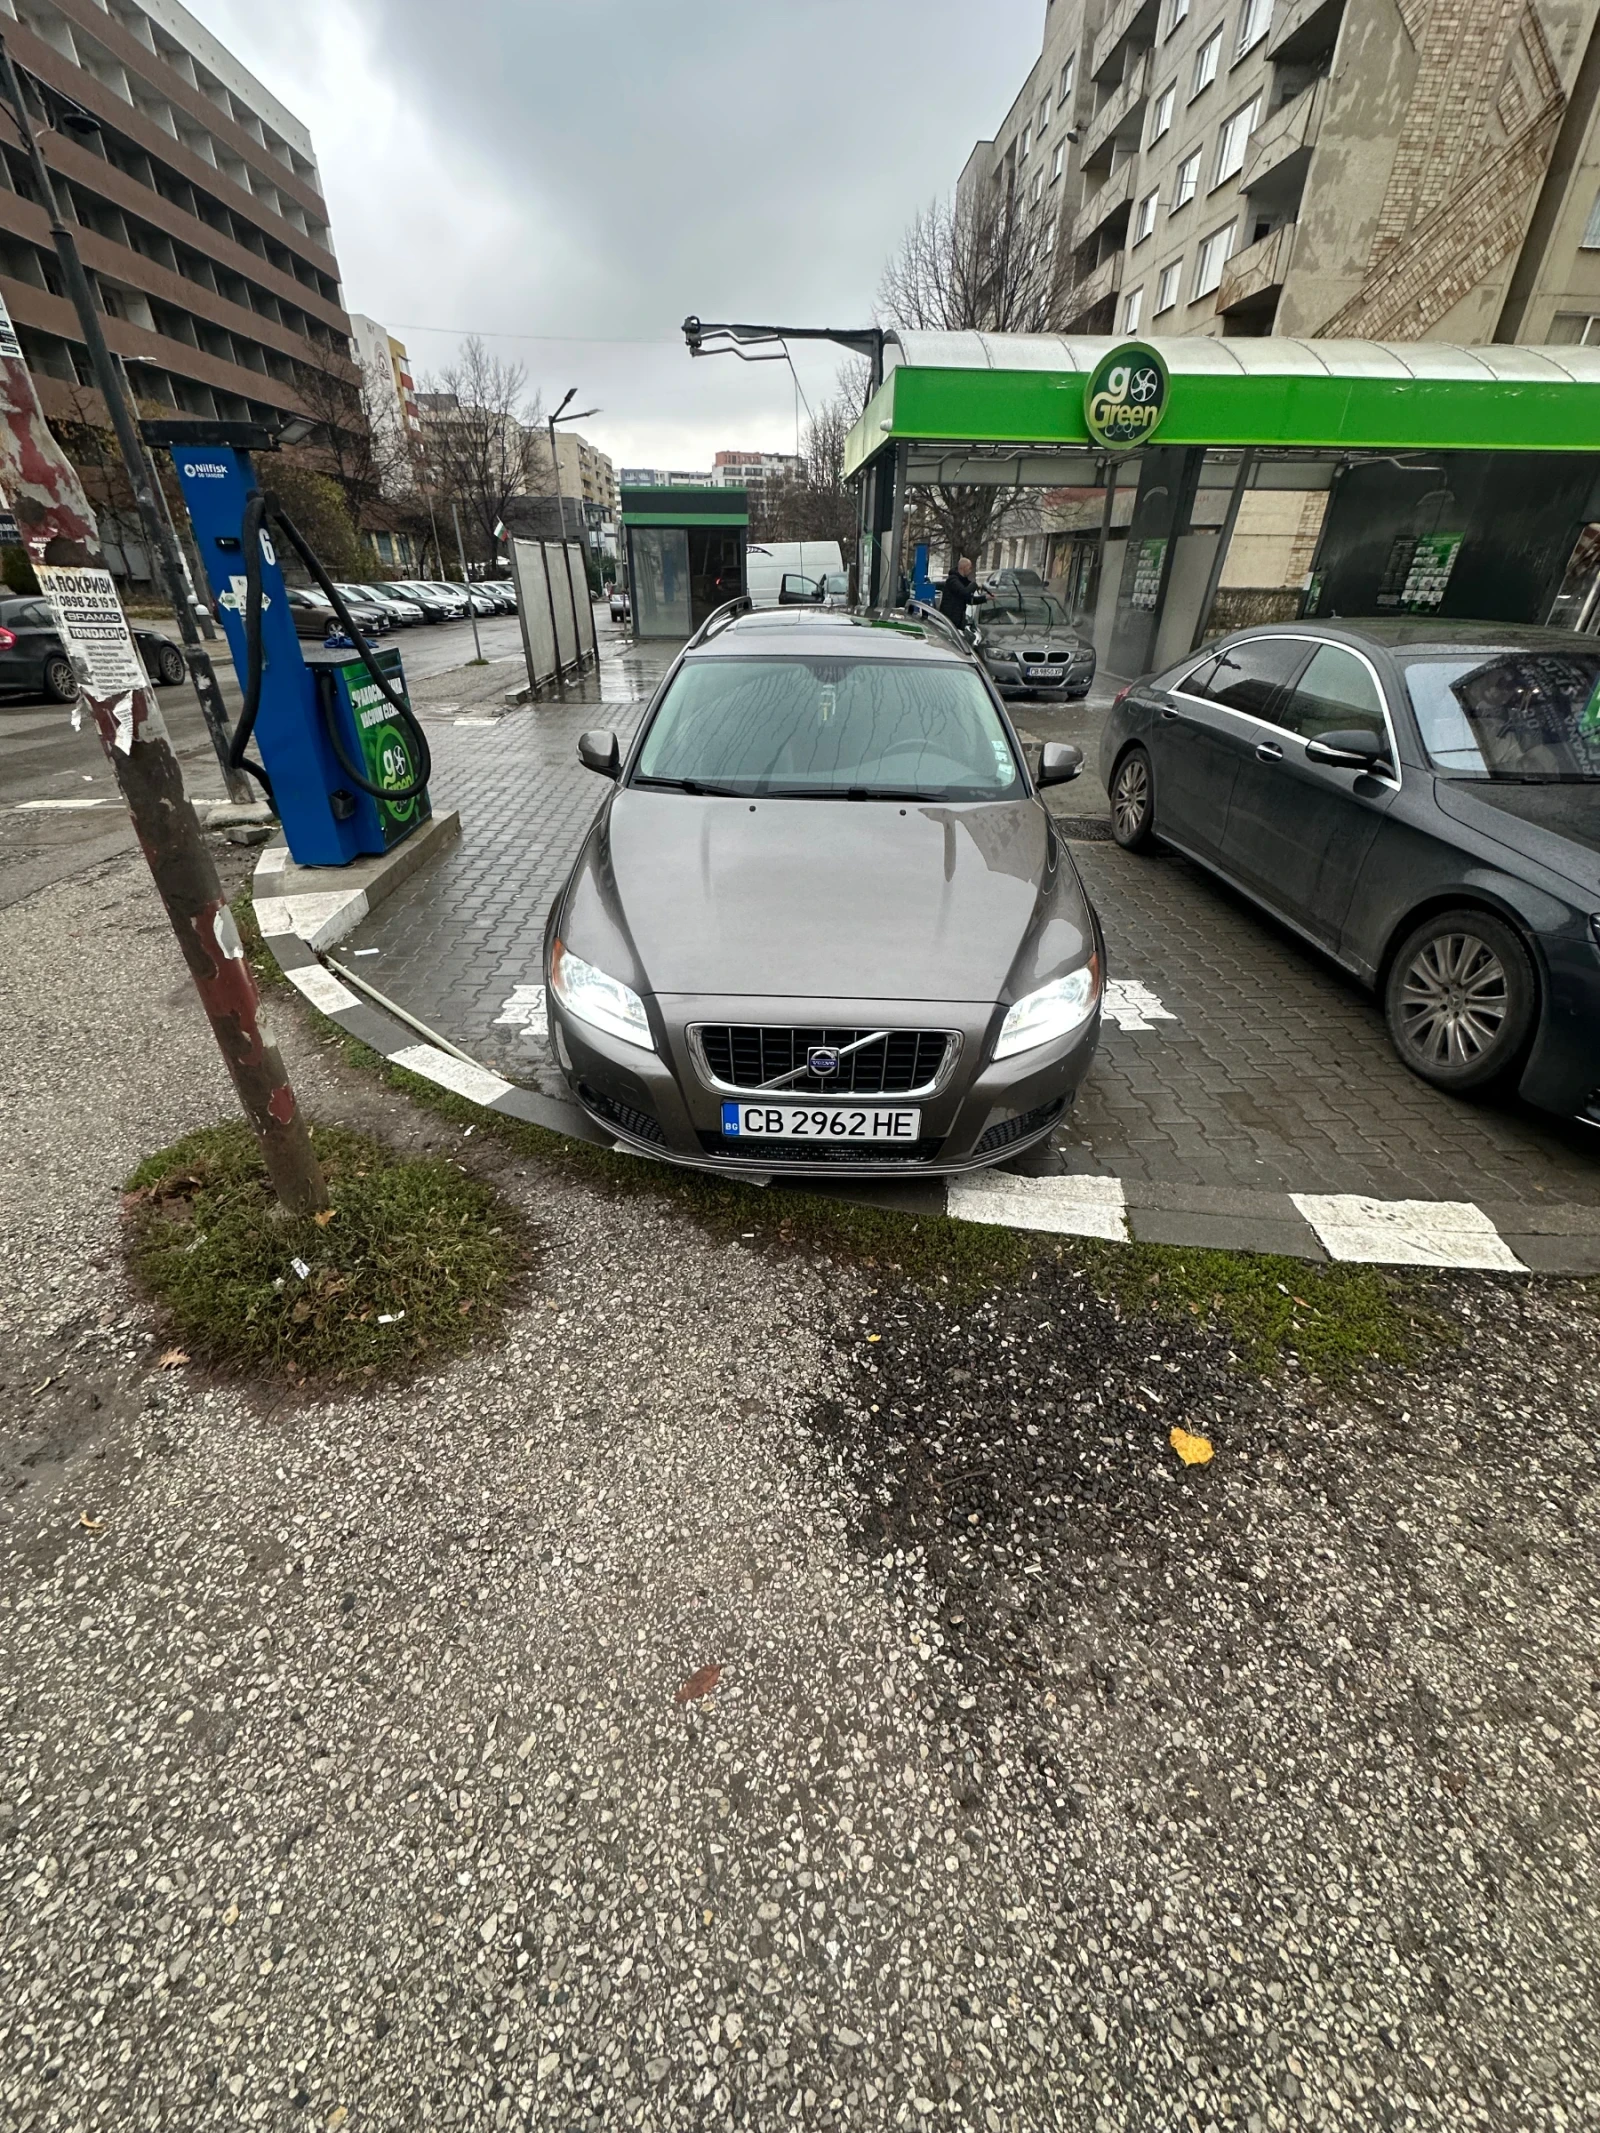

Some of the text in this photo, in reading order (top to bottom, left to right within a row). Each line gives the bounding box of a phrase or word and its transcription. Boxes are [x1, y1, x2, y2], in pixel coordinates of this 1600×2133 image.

[1089, 391, 1158, 430] Green
[195, 463, 229, 474] Nilfisk
[259, 528, 276, 566] 6
[56, 575, 115, 594] ПОКРИВИ
[60, 595, 85, 608] 0898
[85, 595, 99, 608] 28
[99, 597, 109, 609] 19
[109, 597, 118, 608] 19
[67, 612, 120, 622] BRAMAC
[70, 627, 118, 639] TONDACH
[360, 706, 385, 729] VACUUM
[725, 1122, 739, 1131] BG
[744, 1109, 914, 1137] CB 2962 HE
